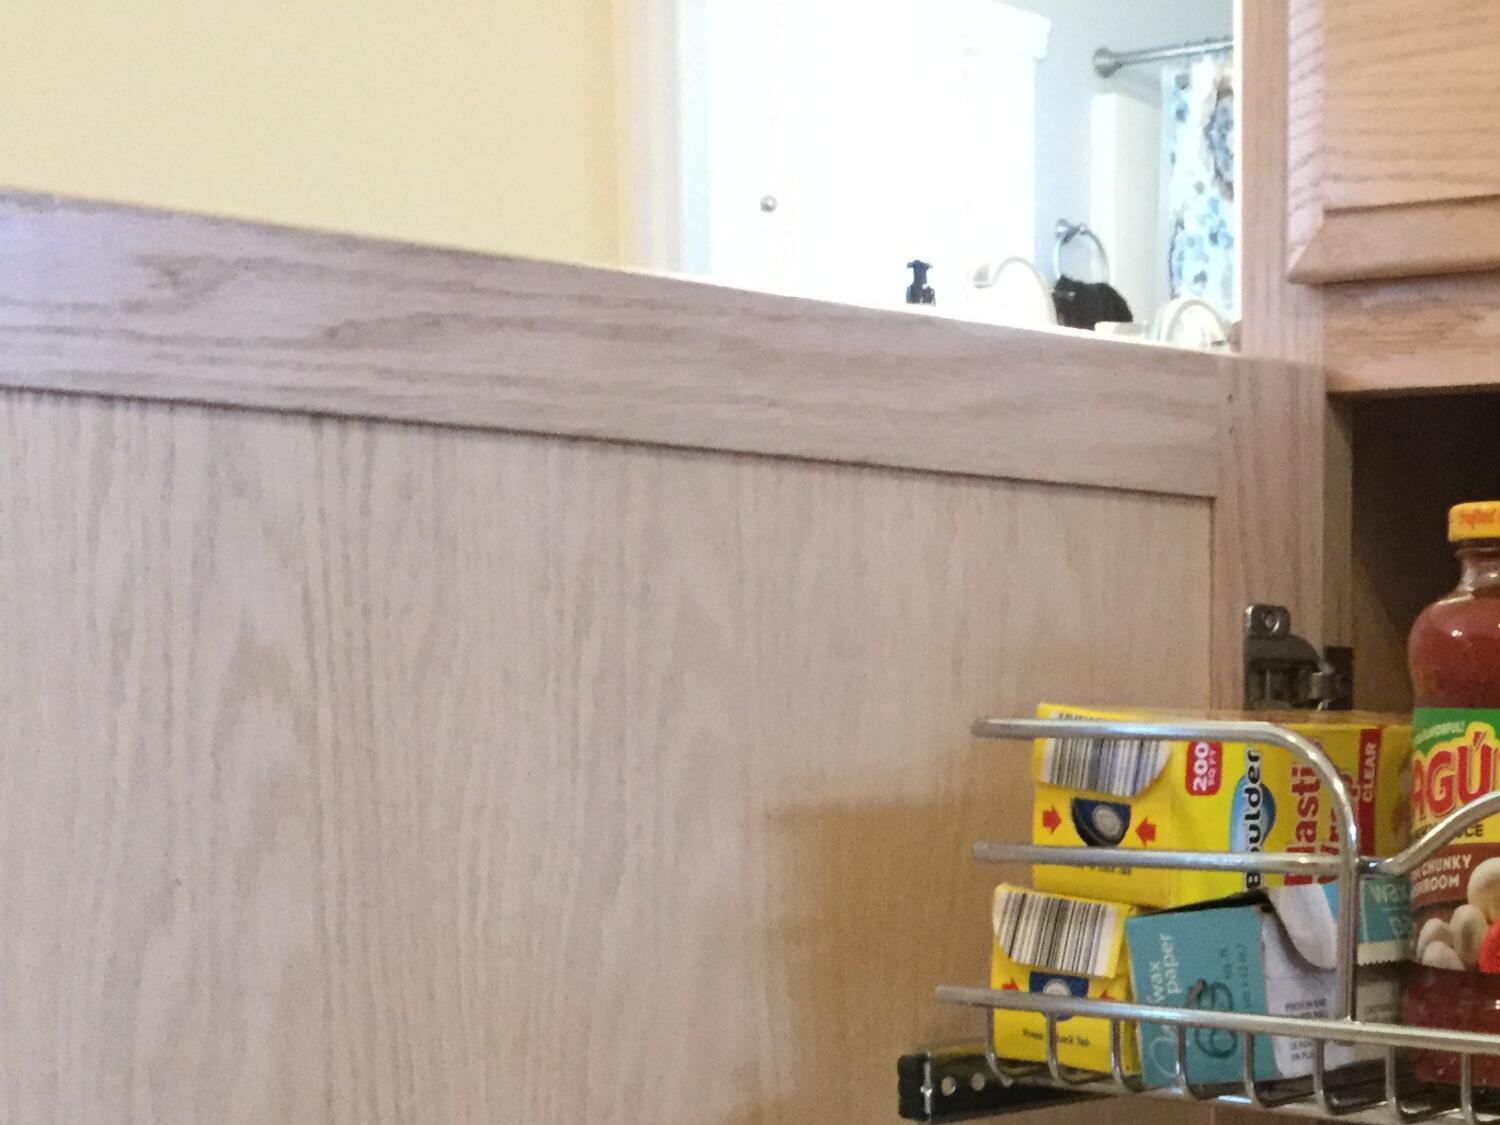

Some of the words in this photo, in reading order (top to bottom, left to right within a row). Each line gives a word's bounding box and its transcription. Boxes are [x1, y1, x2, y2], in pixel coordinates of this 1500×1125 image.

[1193, 742, 1209, 792] 200
[1362, 742, 1377, 802] CLEAR
[1243, 748, 1262, 889] Bulder
[1158, 932, 1182, 994] paper
